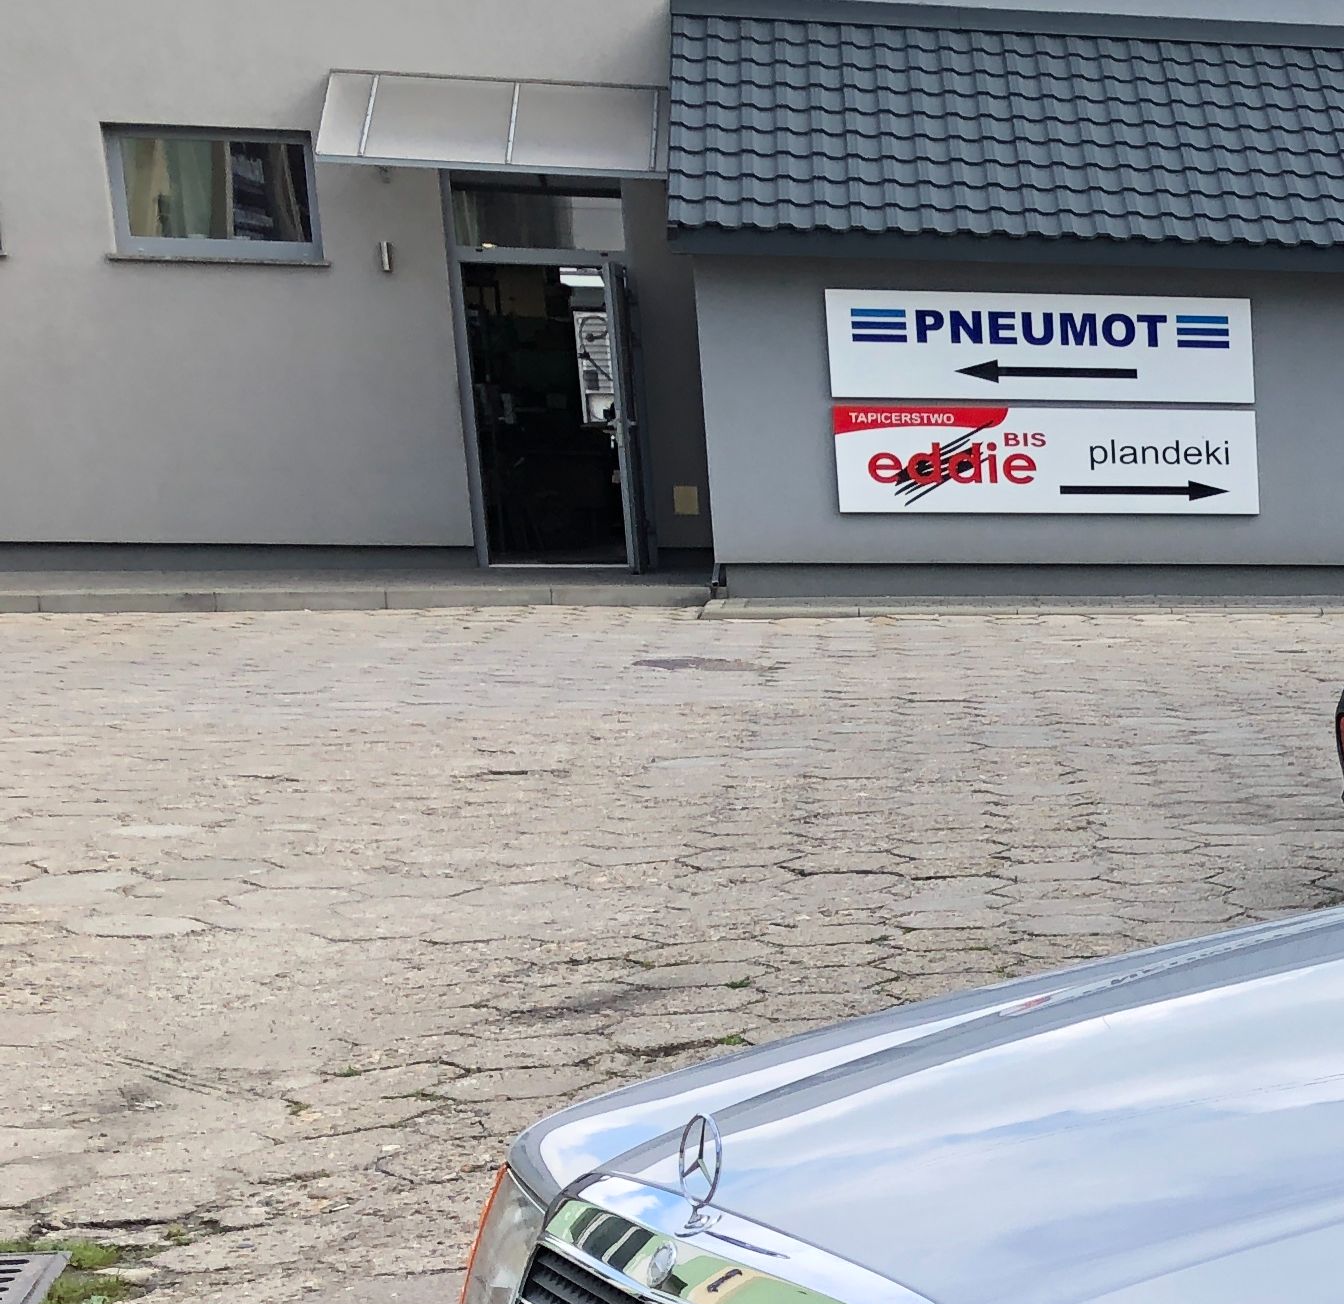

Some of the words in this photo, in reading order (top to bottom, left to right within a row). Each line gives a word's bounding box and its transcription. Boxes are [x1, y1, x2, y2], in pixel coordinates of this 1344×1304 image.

[914, 308, 1168, 348] PNEUMOT
[848, 411, 955, 425] TAPICERSTWO
[1003, 431, 1047, 448] BIS
[1088, 439, 1231, 471] plandeki
[867, 441, 1037, 485] eddie
